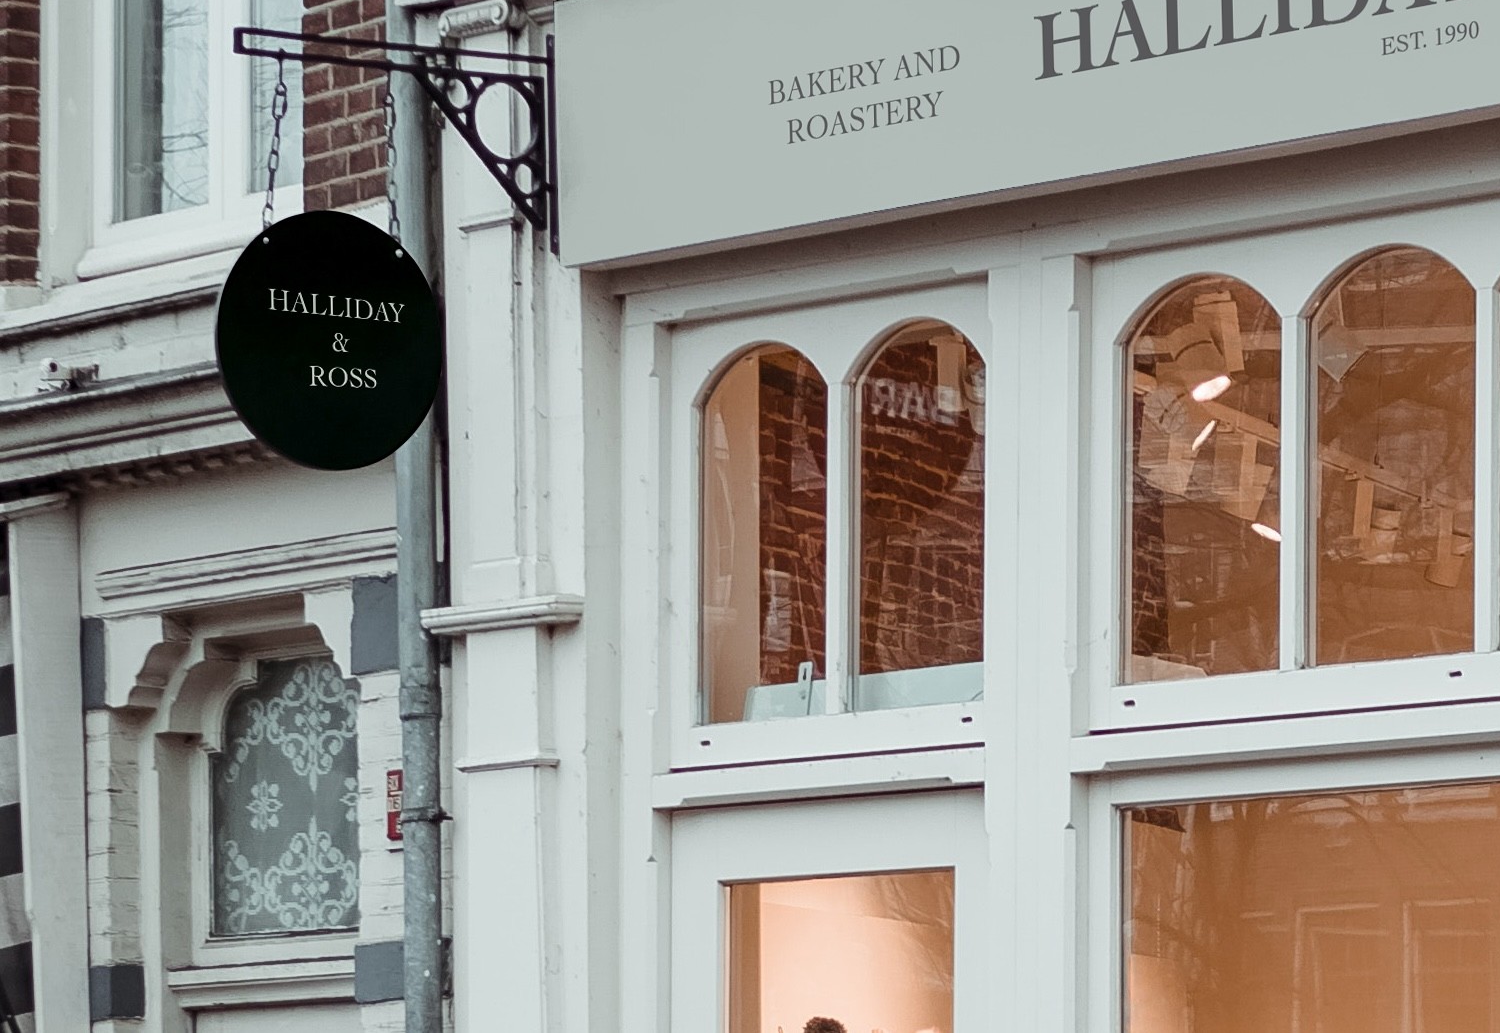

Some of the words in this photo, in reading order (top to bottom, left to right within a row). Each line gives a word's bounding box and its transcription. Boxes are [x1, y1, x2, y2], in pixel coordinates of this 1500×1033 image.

[1381, 30, 1427, 56] EST.
[1435, 20, 1480, 46] 1990
[768, 58, 887, 106] BAKERY
[891, 45, 961, 82] AND
[787, 91, 945, 145] ROASTERY
[268, 288, 405, 323] HALLIDAY
[332, 332, 350, 353] &
[309, 365, 378, 389] ROSS
